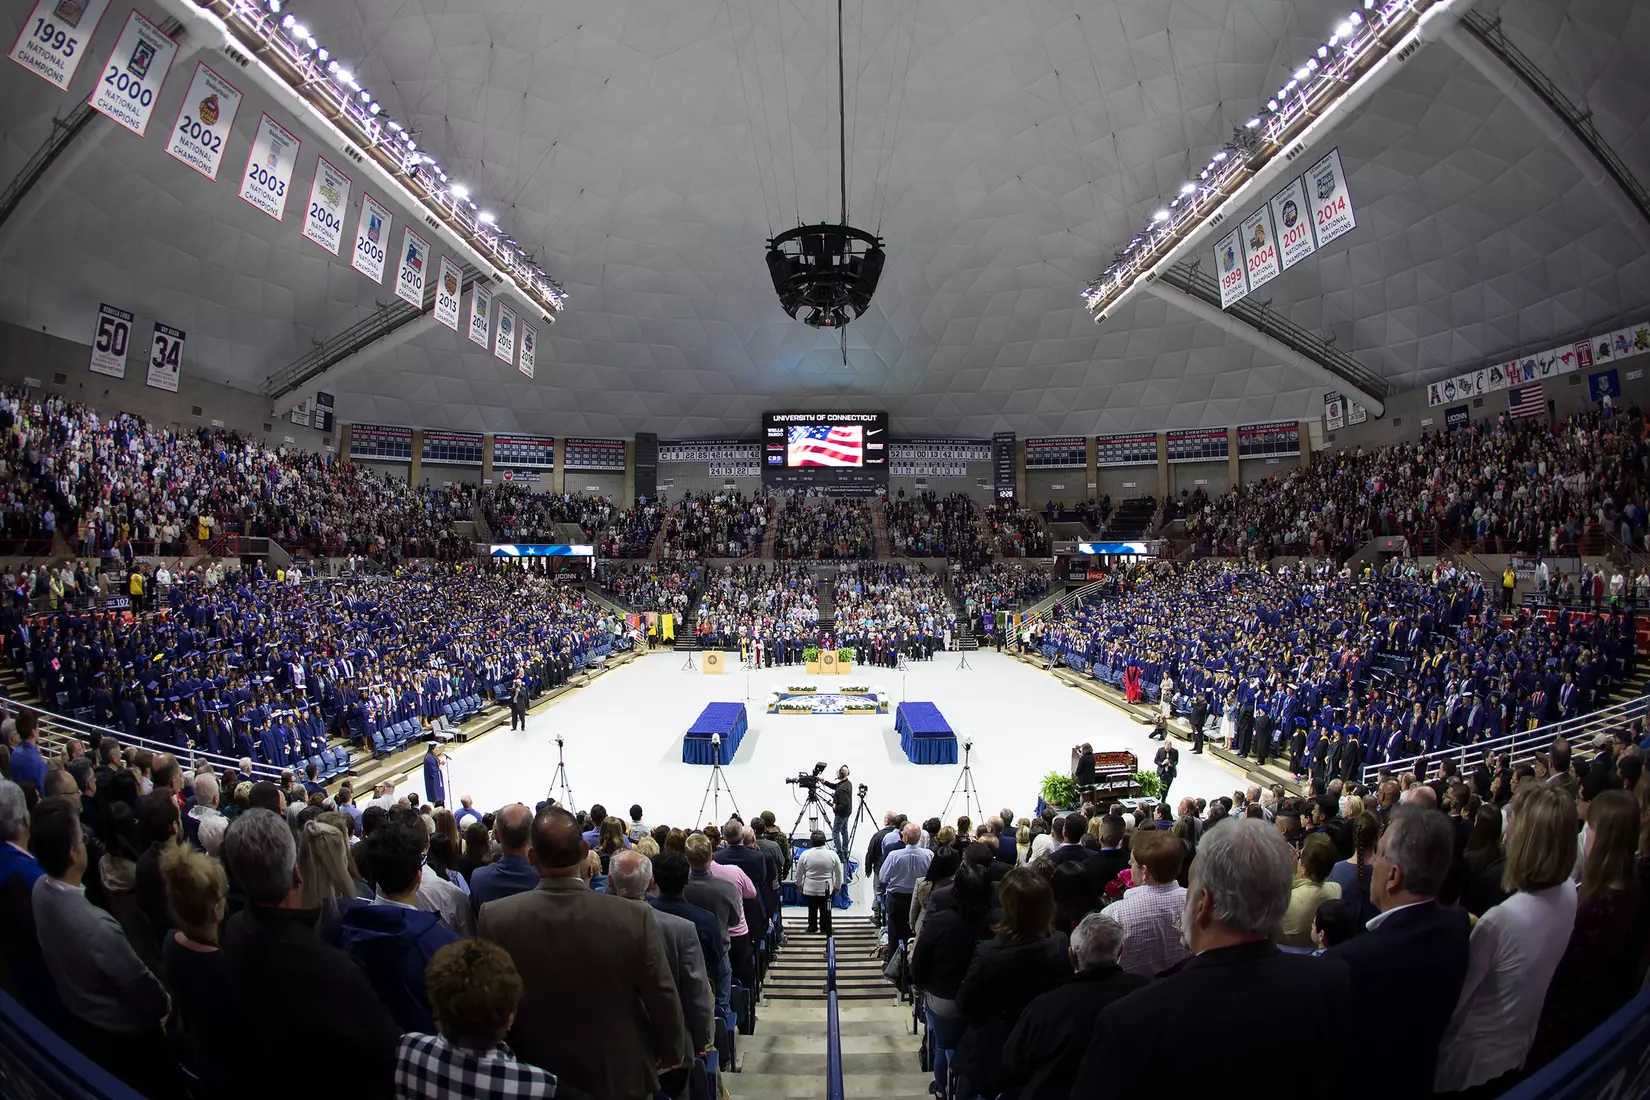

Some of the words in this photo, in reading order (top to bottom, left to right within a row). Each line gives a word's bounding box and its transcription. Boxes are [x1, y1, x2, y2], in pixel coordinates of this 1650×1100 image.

[33, 18, 78, 57] 1995
[18, 50, 64, 83] CHAMPIONS
[26, 40, 65, 70] NATIONAL
[105, 66, 152, 106] 2000
[202, 67, 217, 82] UConn
[105, 89, 140, 116] NATIONAL
[206, 80, 230, 100] Basketball
[98, 98, 140, 129] CHAMPIONS
[180, 116, 221, 154] 2002
[174, 146, 212, 174] CHAMPIONS
[180, 136, 212, 162] NATIONAL
[249, 164, 285, 196] 2003
[245, 192, 278, 216] CHAMPIONS
[250, 183, 277, 206] NATIONAL
[310, 202, 340, 233] 2004
[1317, 196, 1346, 226] 2014
[311, 221, 334, 240] NATIONAL
[1284, 222, 1306, 248] 2011
[1321, 222, 1352, 243] CHAMPIONS
[1322, 214, 1347, 234] NATIONAL
[308, 228, 336, 250] CHAMPIONS
[358, 237, 384, 263] 2009
[1286, 240, 1308, 256] NATIONAL
[1249, 246, 1274, 272] 2004
[1286, 246, 1312, 266] CHAMPIONS
[401, 267, 422, 290] 2010
[1222, 268, 1242, 290] 1999
[1252, 269, 1276, 288] CHAMPIONS
[1253, 263, 1274, 278] NATIONAL
[439, 293, 456, 312] 2013
[96, 316, 128, 356] 50
[153, 336, 180, 373] 34
[1448, 412, 1467, 422] UCONN
[1535, 596, 1546, 604] 123
